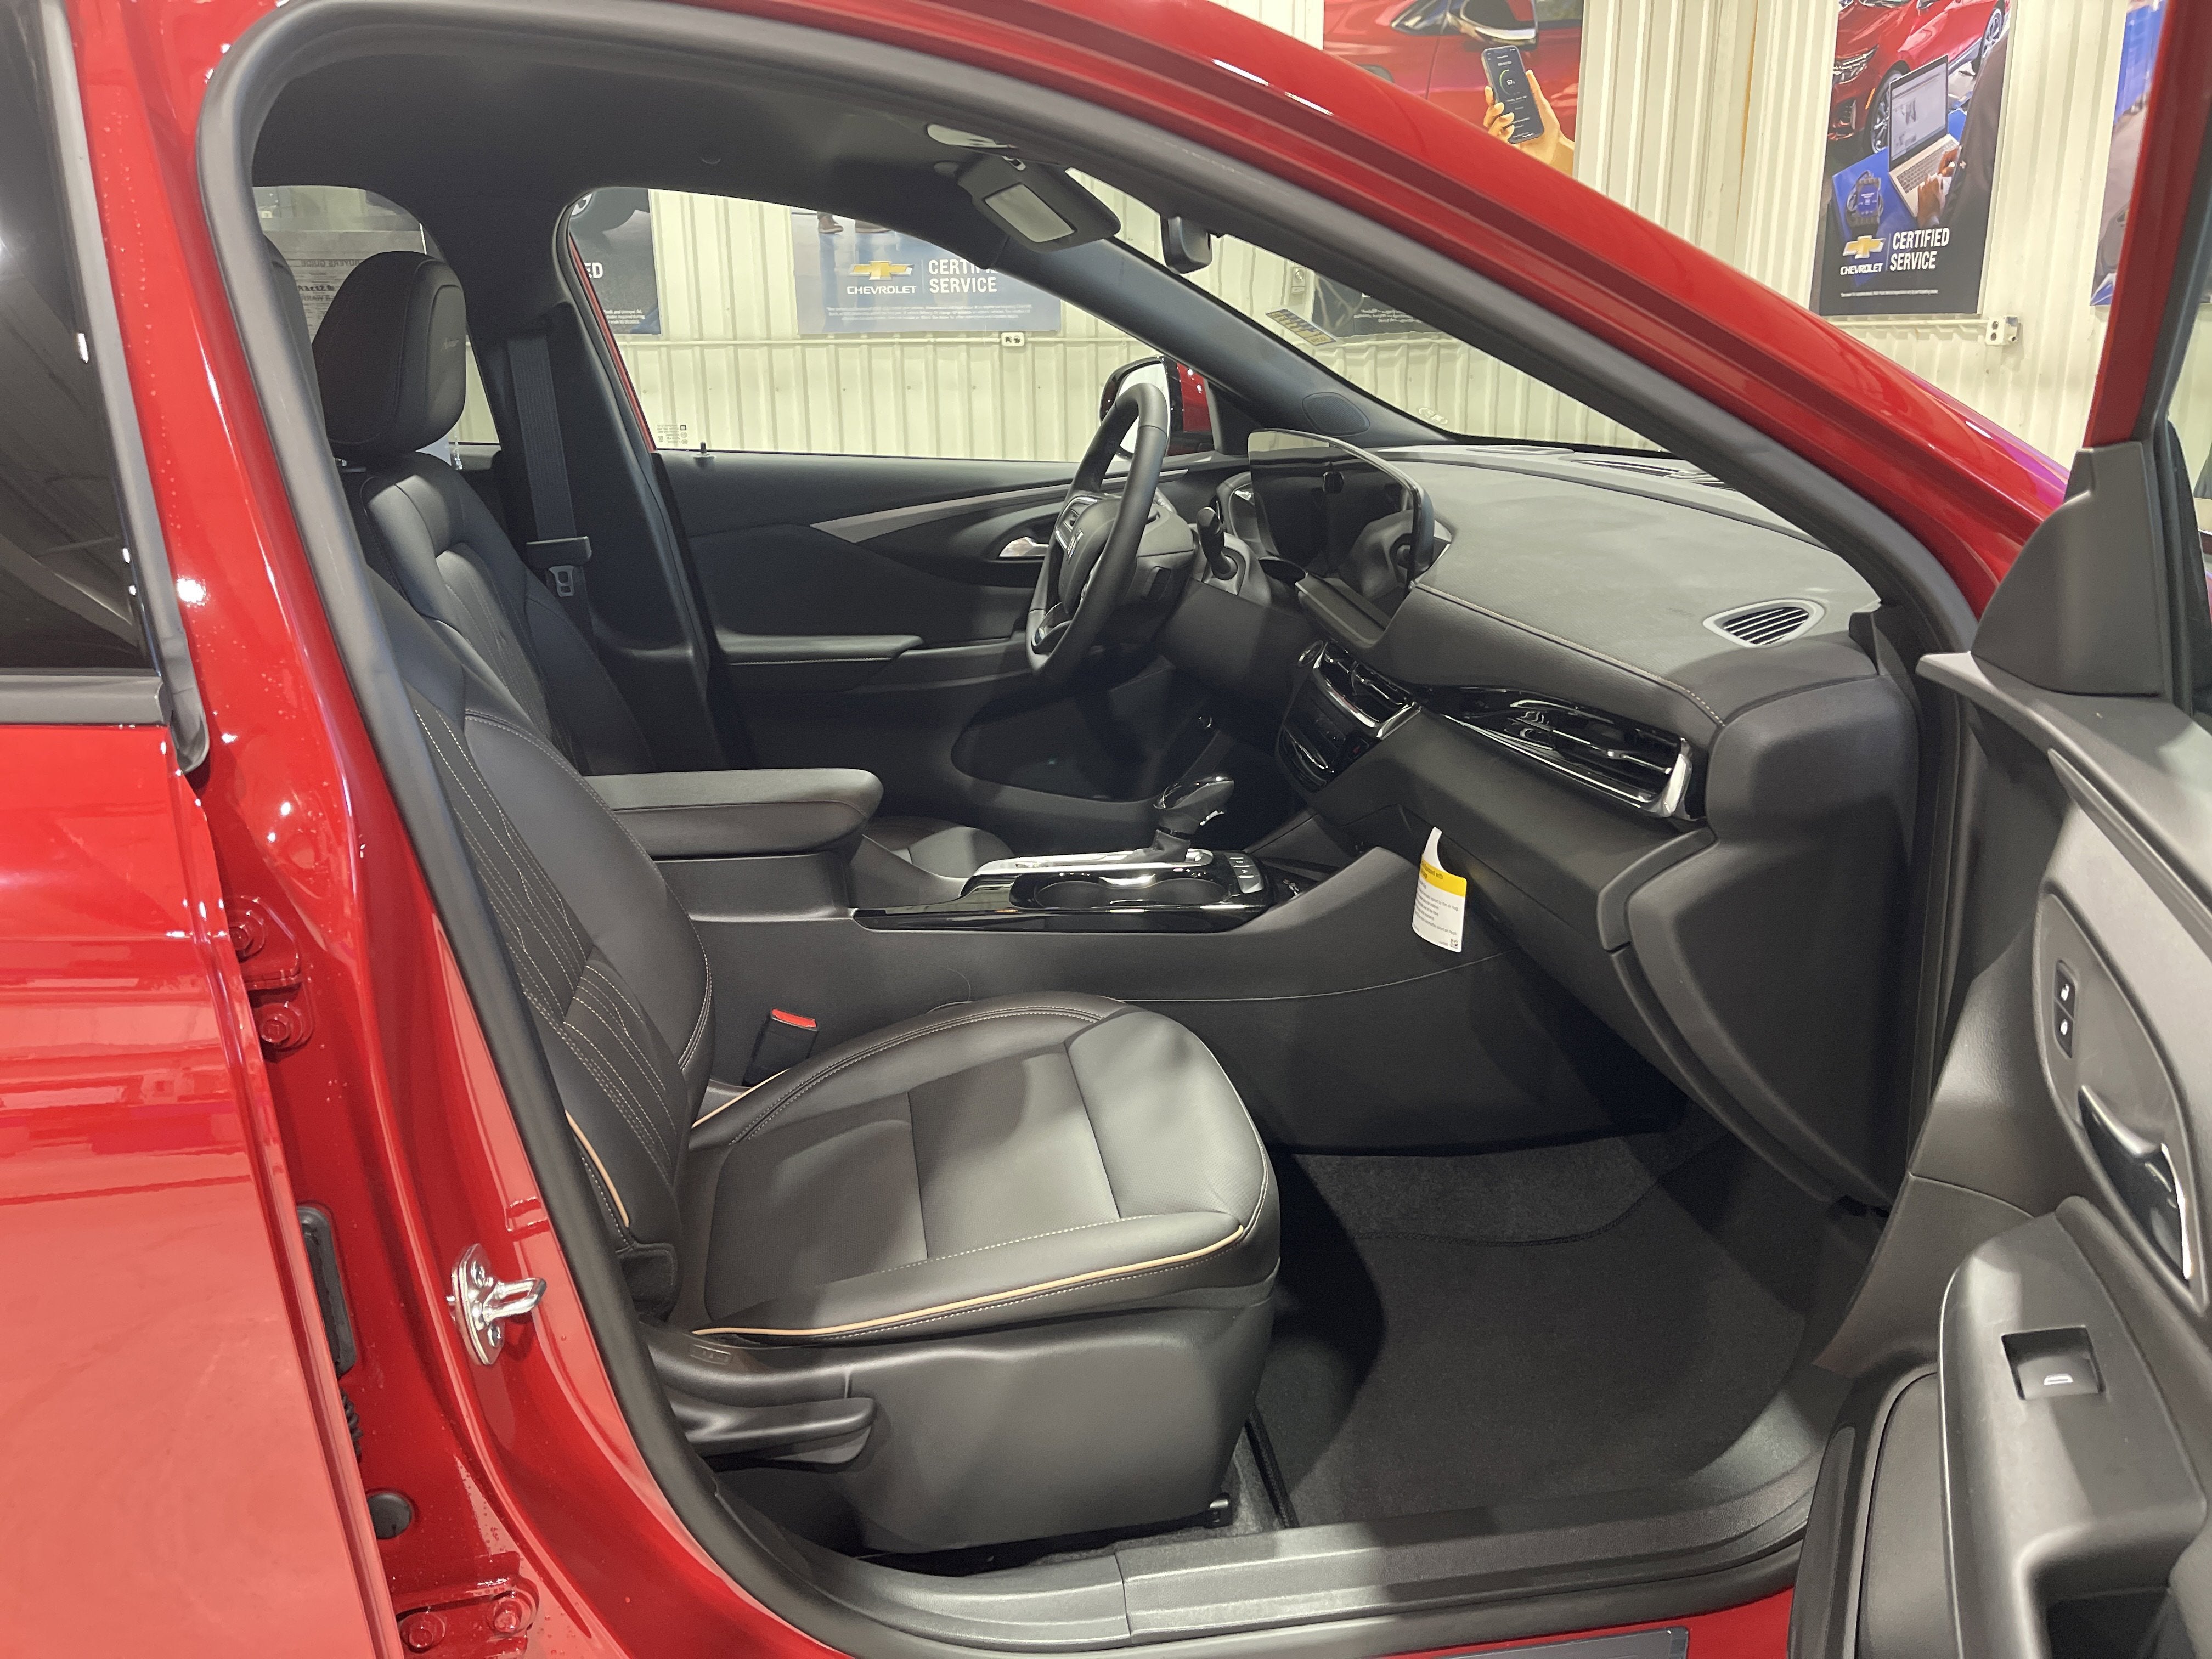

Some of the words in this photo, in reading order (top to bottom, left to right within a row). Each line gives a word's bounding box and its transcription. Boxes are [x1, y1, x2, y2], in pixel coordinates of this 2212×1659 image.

[1893, 228, 1950, 250] CERTIFIED
[929, 258, 998, 275] CERTI
[1840, 263, 1883, 275] CHEVROLET
[1889, 251, 1937, 272] SERVICE
[847, 285, 917, 295] CHEVROLET
[929, 276, 997, 294] SERVICE
